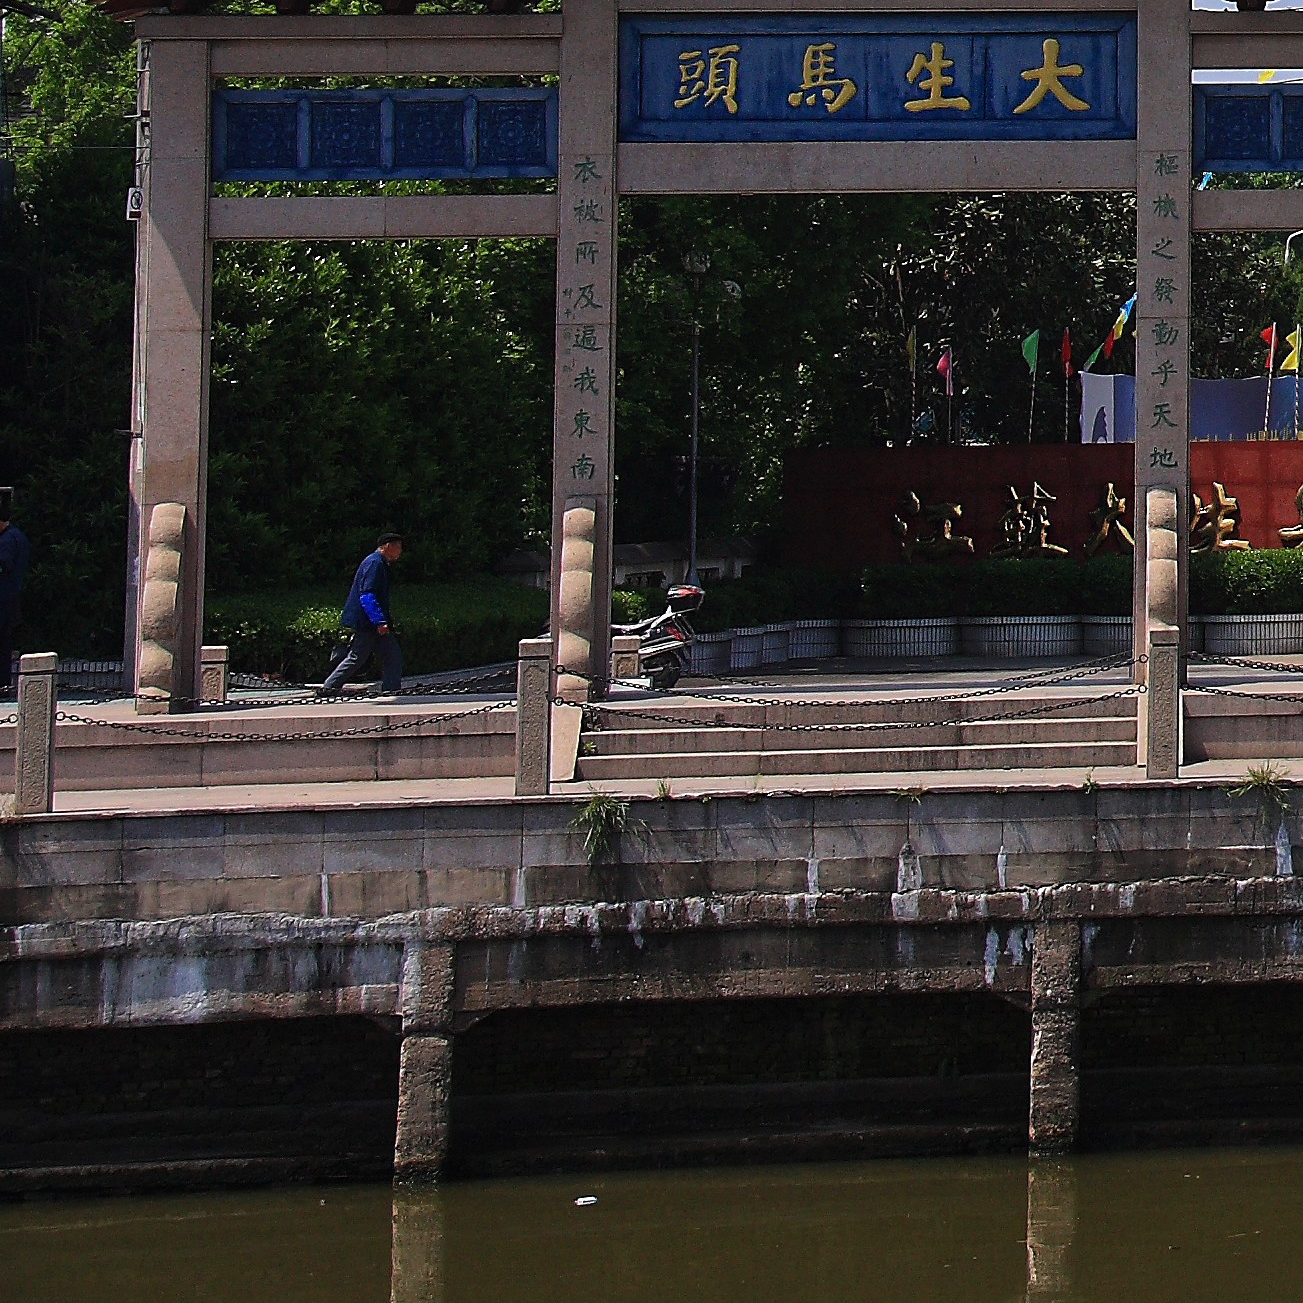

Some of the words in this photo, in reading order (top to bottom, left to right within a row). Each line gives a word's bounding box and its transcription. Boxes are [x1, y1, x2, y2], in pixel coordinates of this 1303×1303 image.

[673, 37, 1091, 114] 大生馬頭
[571, 155, 604, 480] 衣被所及遍我東南
